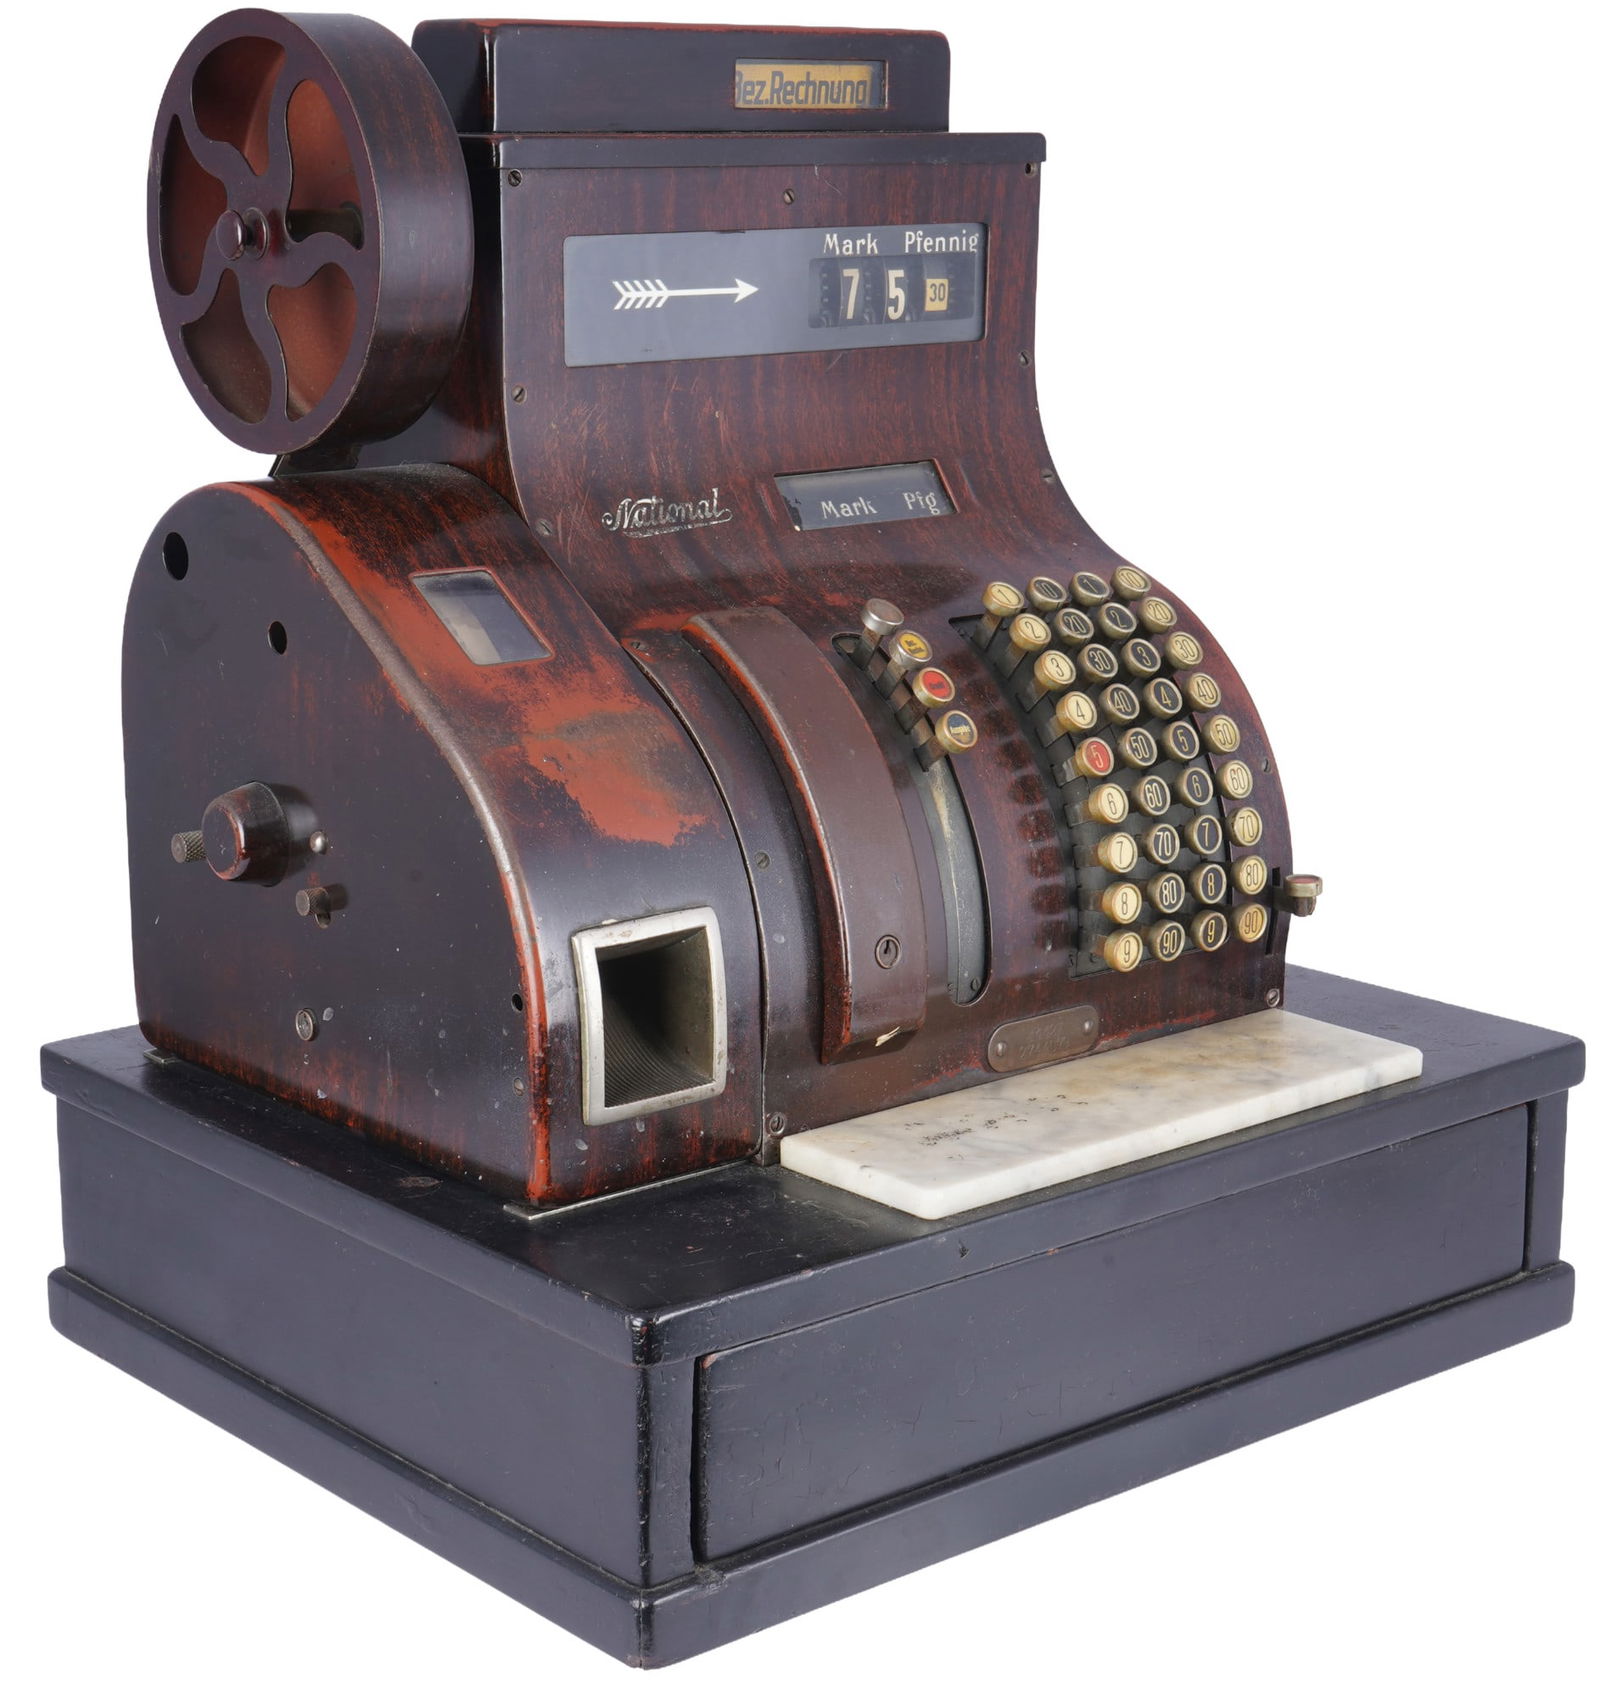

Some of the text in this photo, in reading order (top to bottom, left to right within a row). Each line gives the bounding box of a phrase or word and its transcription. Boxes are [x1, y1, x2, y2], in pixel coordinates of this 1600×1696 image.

[823, 229, 979, 255] Mark Pfennig
[842, 268, 946, 320] 7 5 30
[602, 488, 733, 537] National
[821, 491, 940, 518] Mark Pfg
[1035, 582, 1058, 598] 10
[1083, 579, 1098, 593] 1
[1120, 571, 1142, 587] 10
[997, 589, 1012, 604] 1
[1111, 611, 1127, 628] 2
[1149, 603, 1169, 621] 20
[1025, 621, 1042, 639] 2
[1064, 614, 1086, 634] 20
[1137, 646, 1151, 666] 3
[1175, 639, 1195, 658] 30
[1050, 657, 1064, 677] 3
[1089, 650, 1111, 671] 30
[1160, 685, 1172, 707] 4
[1197, 680, 1214, 699] 40
[1076, 701, 1086, 720] 4
[1113, 691, 1132, 712] 40
[1176, 729, 1188, 751] 5
[1217, 721, 1236, 745] 50
[1091, 744, 1105, 768] 5
[1131, 735, 1151, 760] 50
[1192, 775, 1202, 798] 6
[1229, 767, 1246, 791] 60
[1106, 791, 1117, 815] 6
[1144, 783, 1163, 808] 60
[1201, 822, 1210, 847] 7
[1239, 815, 1255, 838] 70
[1116, 841, 1126, 865] 7
[1157, 831, 1171, 857] 70
[1207, 872, 1214, 896] 8
[1245, 863, 1259, 887] 80
[1121, 892, 1129, 915] 8
[1161, 880, 1177, 905] 80
[1207, 920, 1215, 943] 9
[1244, 911, 1258, 934] 90
[1123, 940, 1131, 963] 9
[1162, 930, 1178, 955] 90
